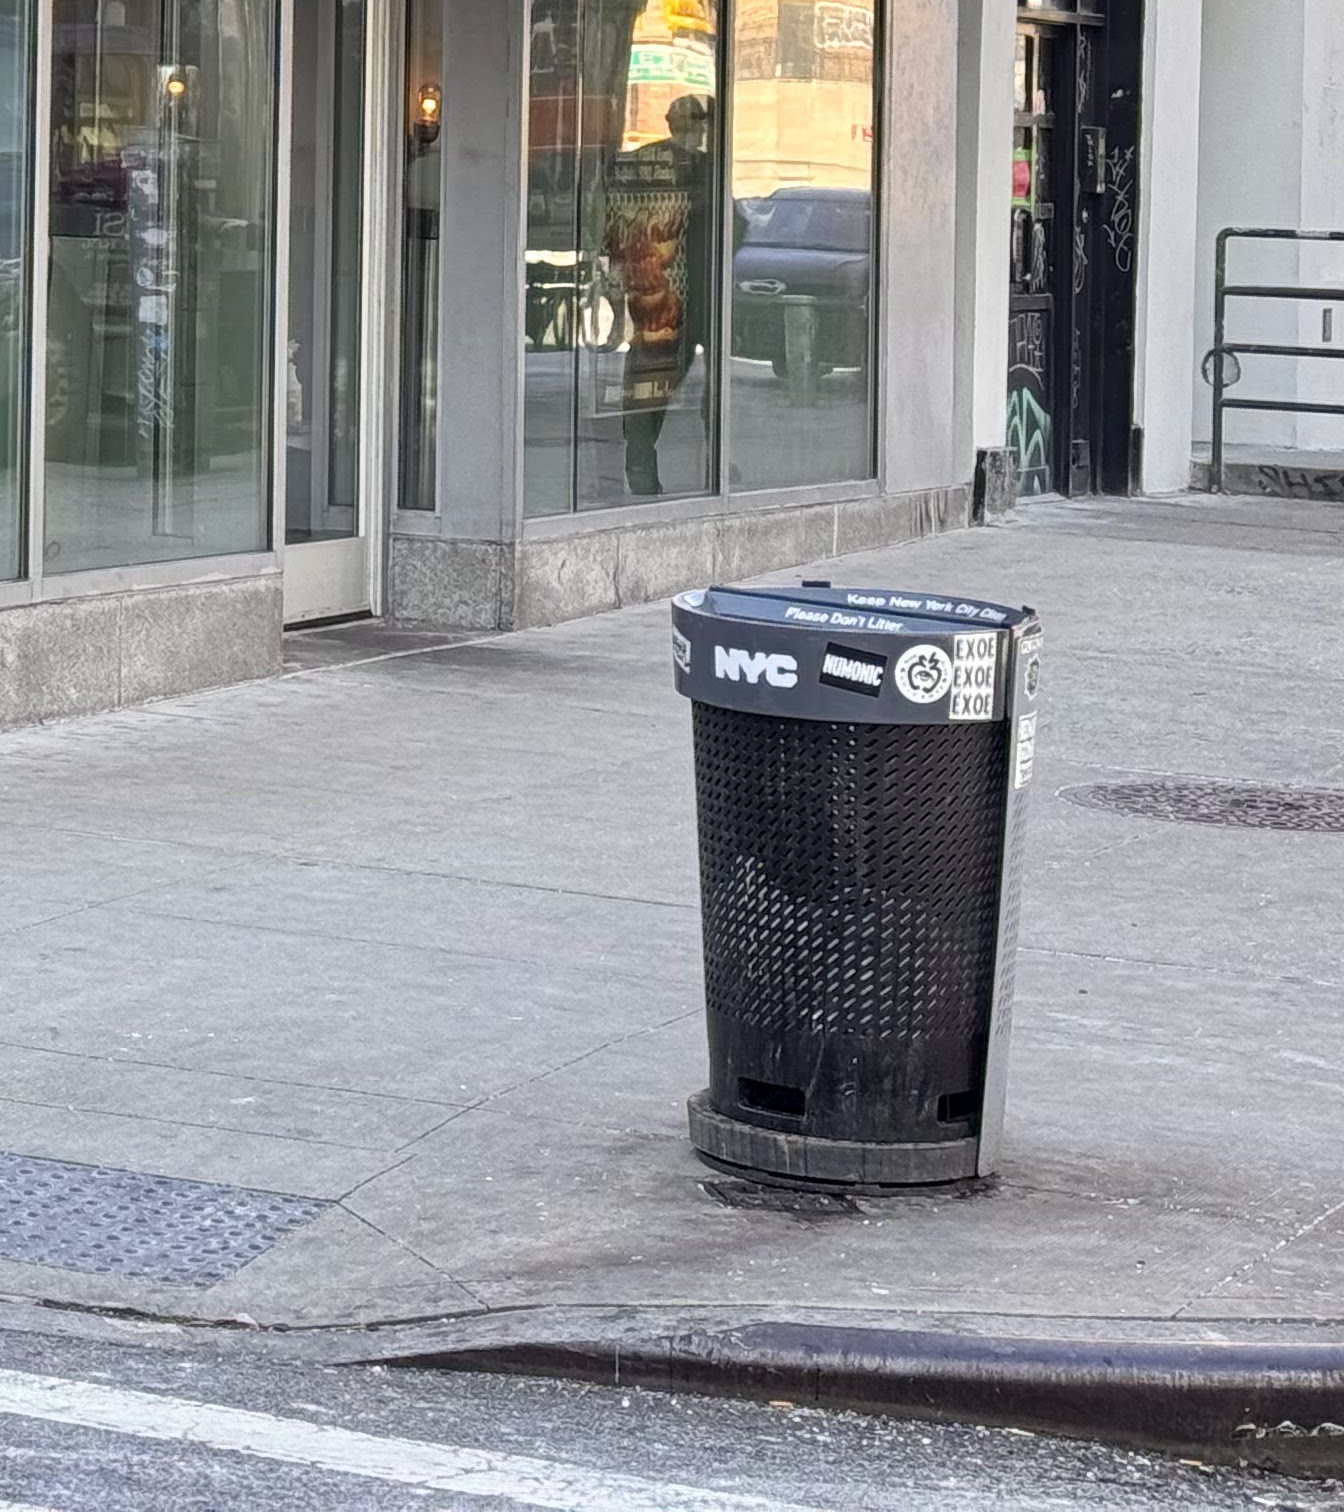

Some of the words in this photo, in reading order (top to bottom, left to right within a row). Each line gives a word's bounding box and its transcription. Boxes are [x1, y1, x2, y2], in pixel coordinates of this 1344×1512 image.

[847, 593, 886, 608] Keep
[889, 596, 922, 609] New
[925, 599, 954, 614] York
[785, 607, 826, 624] Please
[830, 612, 865, 627] Don't
[868, 617, 904, 632] Litter
[715, 645, 798, 688] NYC
